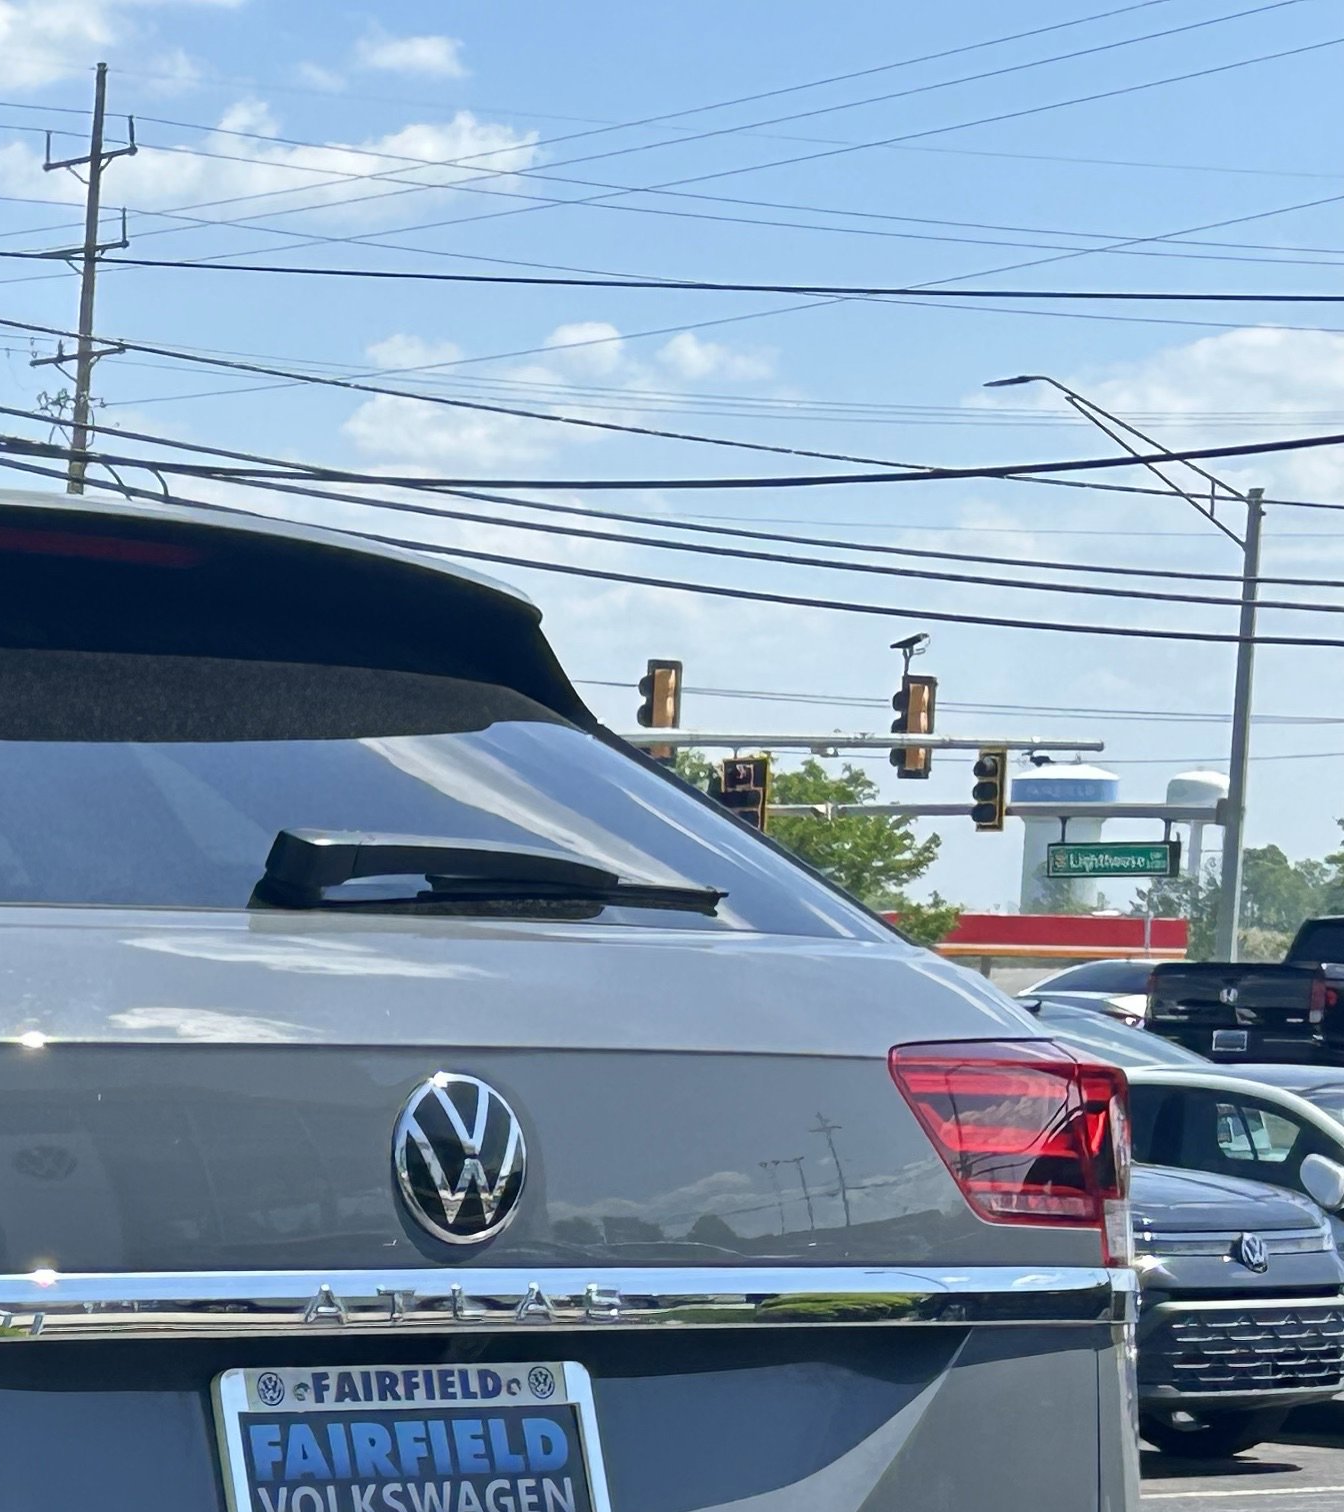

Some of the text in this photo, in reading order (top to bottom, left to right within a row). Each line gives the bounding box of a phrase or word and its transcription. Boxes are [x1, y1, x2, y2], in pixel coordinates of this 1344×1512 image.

[305, 1283, 621, 1325] ATLAS
[312, 1369, 502, 1403] FAIRFIELD
[249, 1417, 569, 1481] FAIRFIELD
